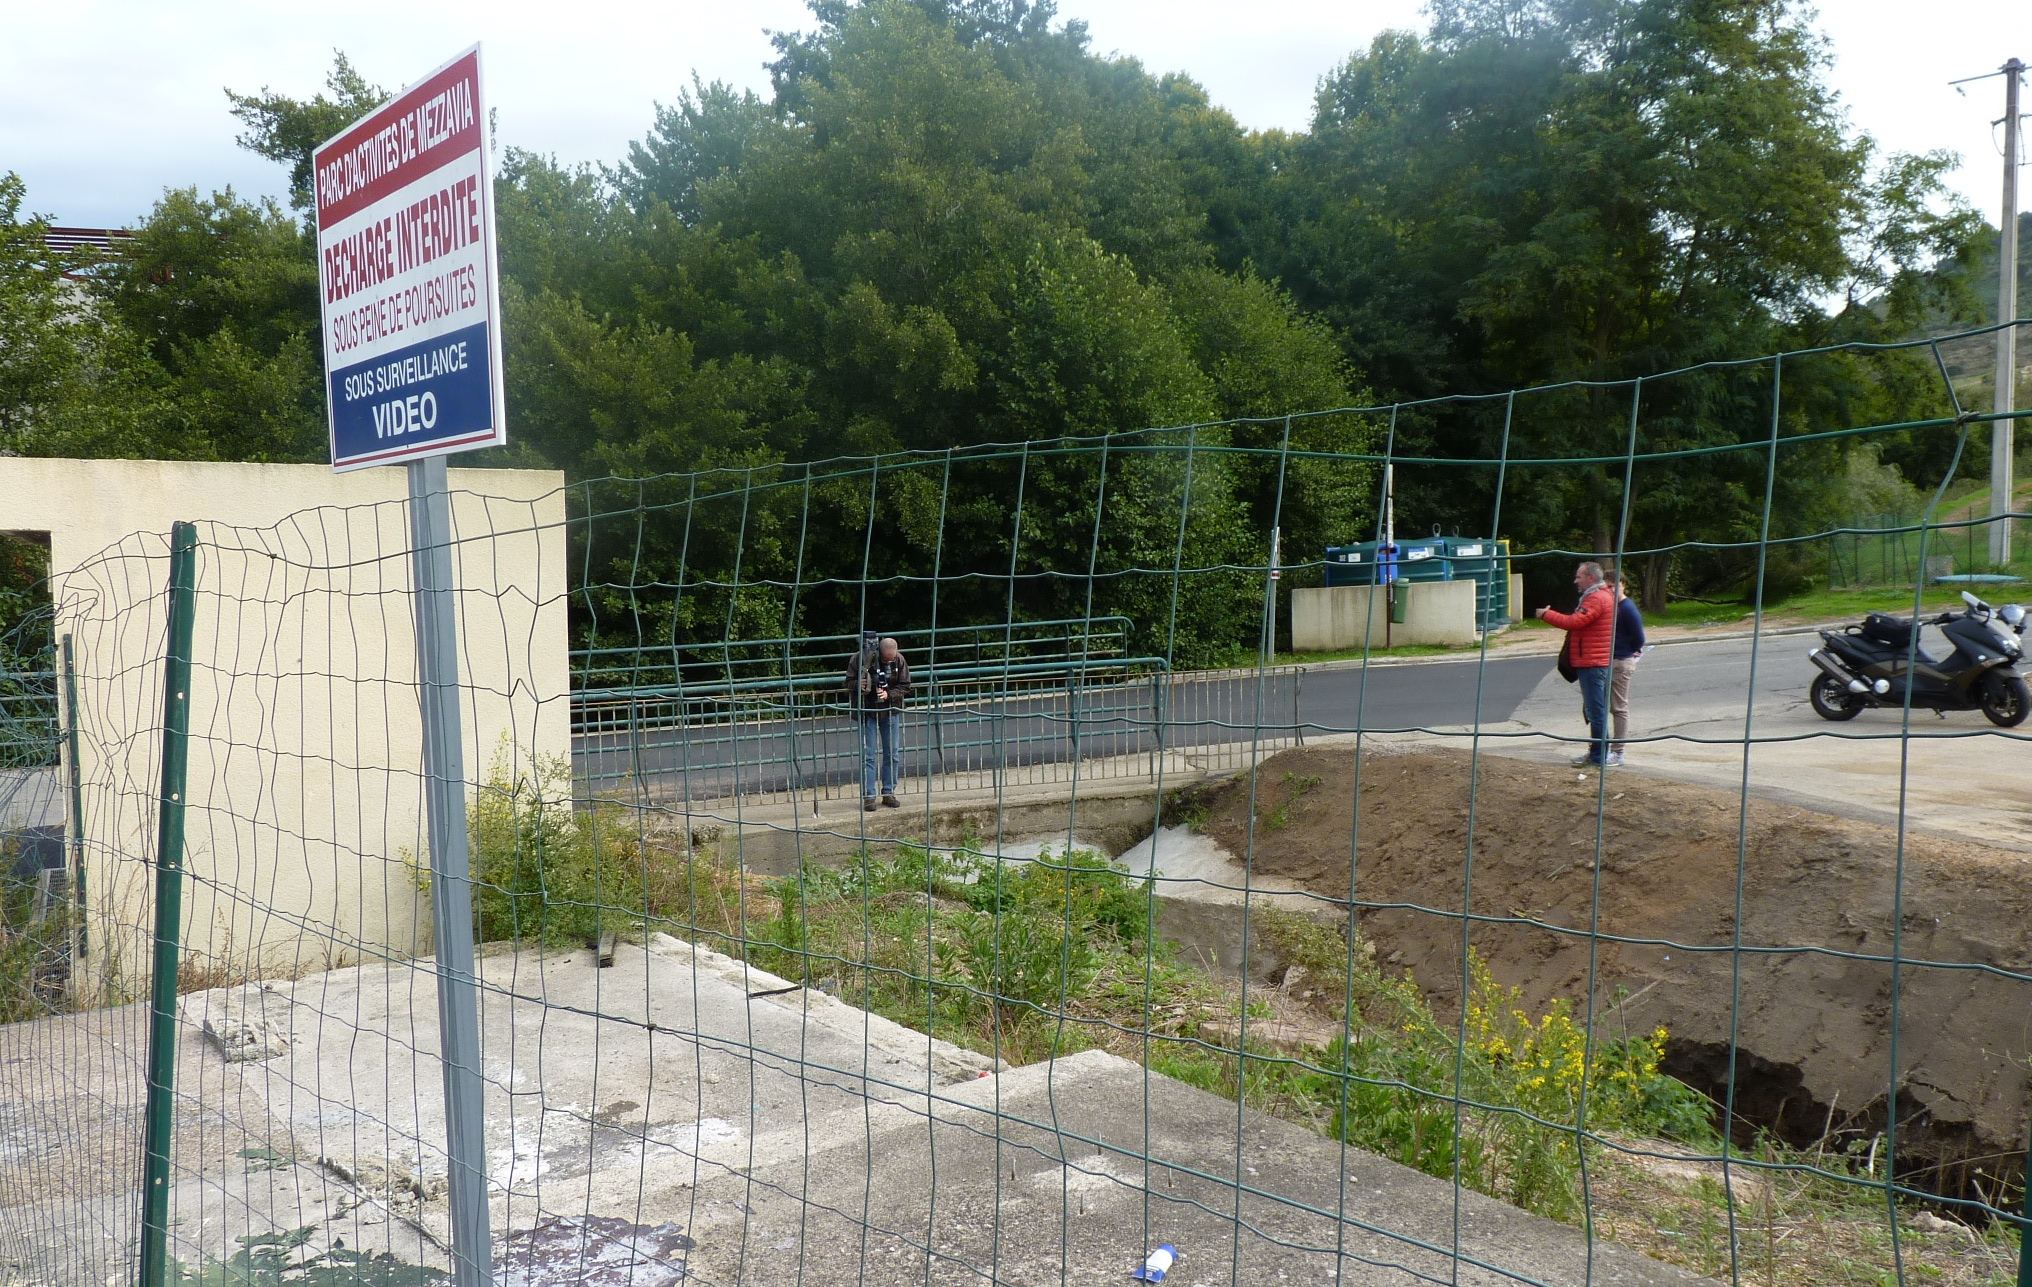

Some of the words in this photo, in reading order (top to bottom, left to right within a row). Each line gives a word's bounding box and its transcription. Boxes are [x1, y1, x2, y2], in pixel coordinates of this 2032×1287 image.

[320, 158, 344, 210] PARC
[344, 122, 399, 196] D'ACTIVITES
[400, 112, 416, 164] DE
[416, 78, 474, 155] MEZZAVIA
[325, 217, 394, 305] DECHARGE
[396, 174, 479, 274] INTERDITE
[333, 310, 358, 354] SOUS
[359, 298, 388, 345] PEINE
[389, 292, 404, 335] DE
[404, 263, 476, 329] POURSUITES
[345, 370, 375, 401] SOUS
[376, 341, 468, 393] SURVEILLANCE
[372, 391, 438, 439] VIDEO
